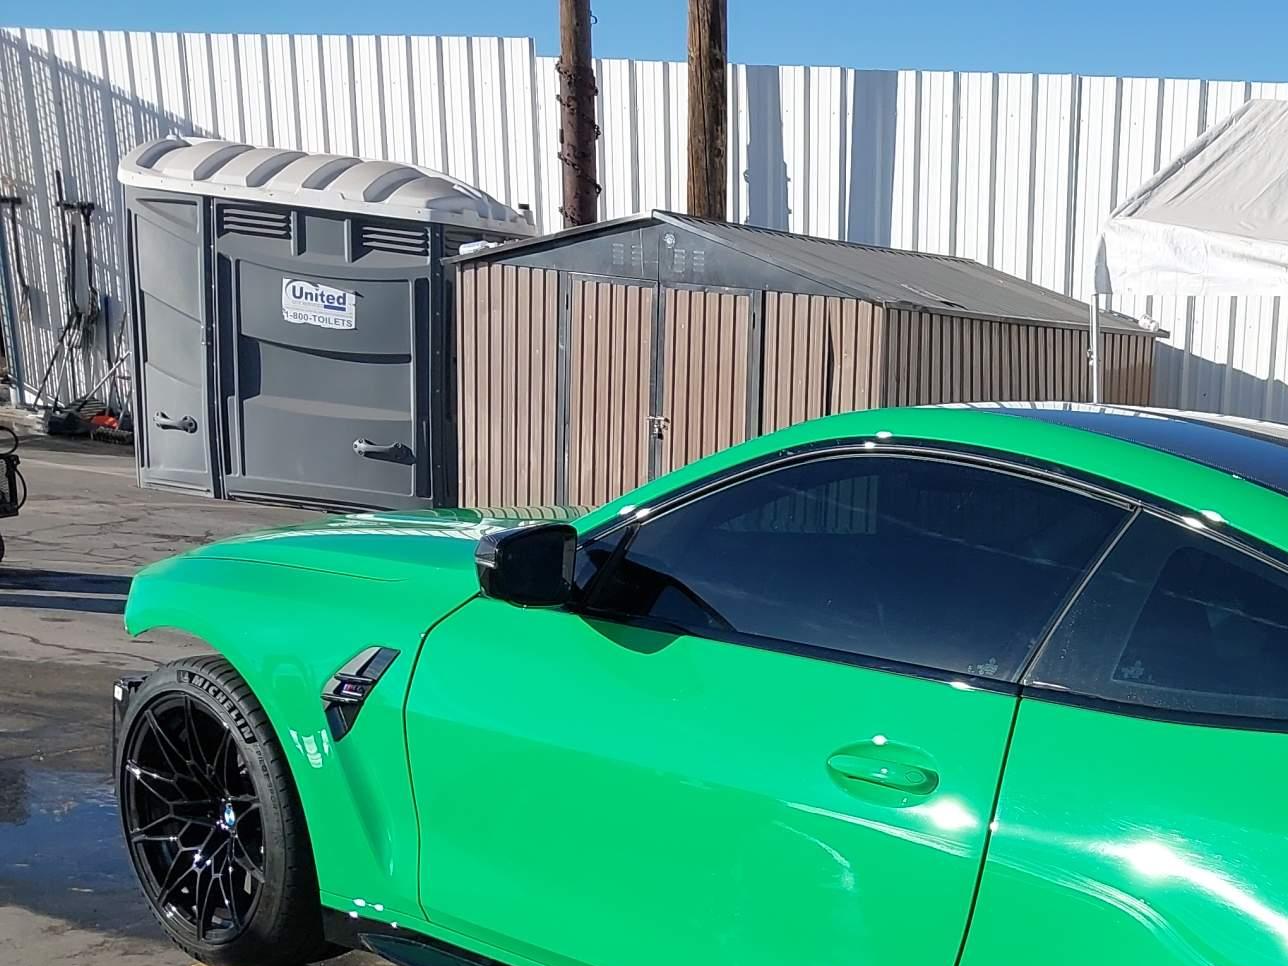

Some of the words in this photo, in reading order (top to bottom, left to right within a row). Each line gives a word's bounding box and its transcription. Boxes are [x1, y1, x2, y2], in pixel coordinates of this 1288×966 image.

[291, 285, 347, 306] United
[284, 311, 353, 328] 1-800-TOILETS
[191, 674, 254, 739] MICHELIN
